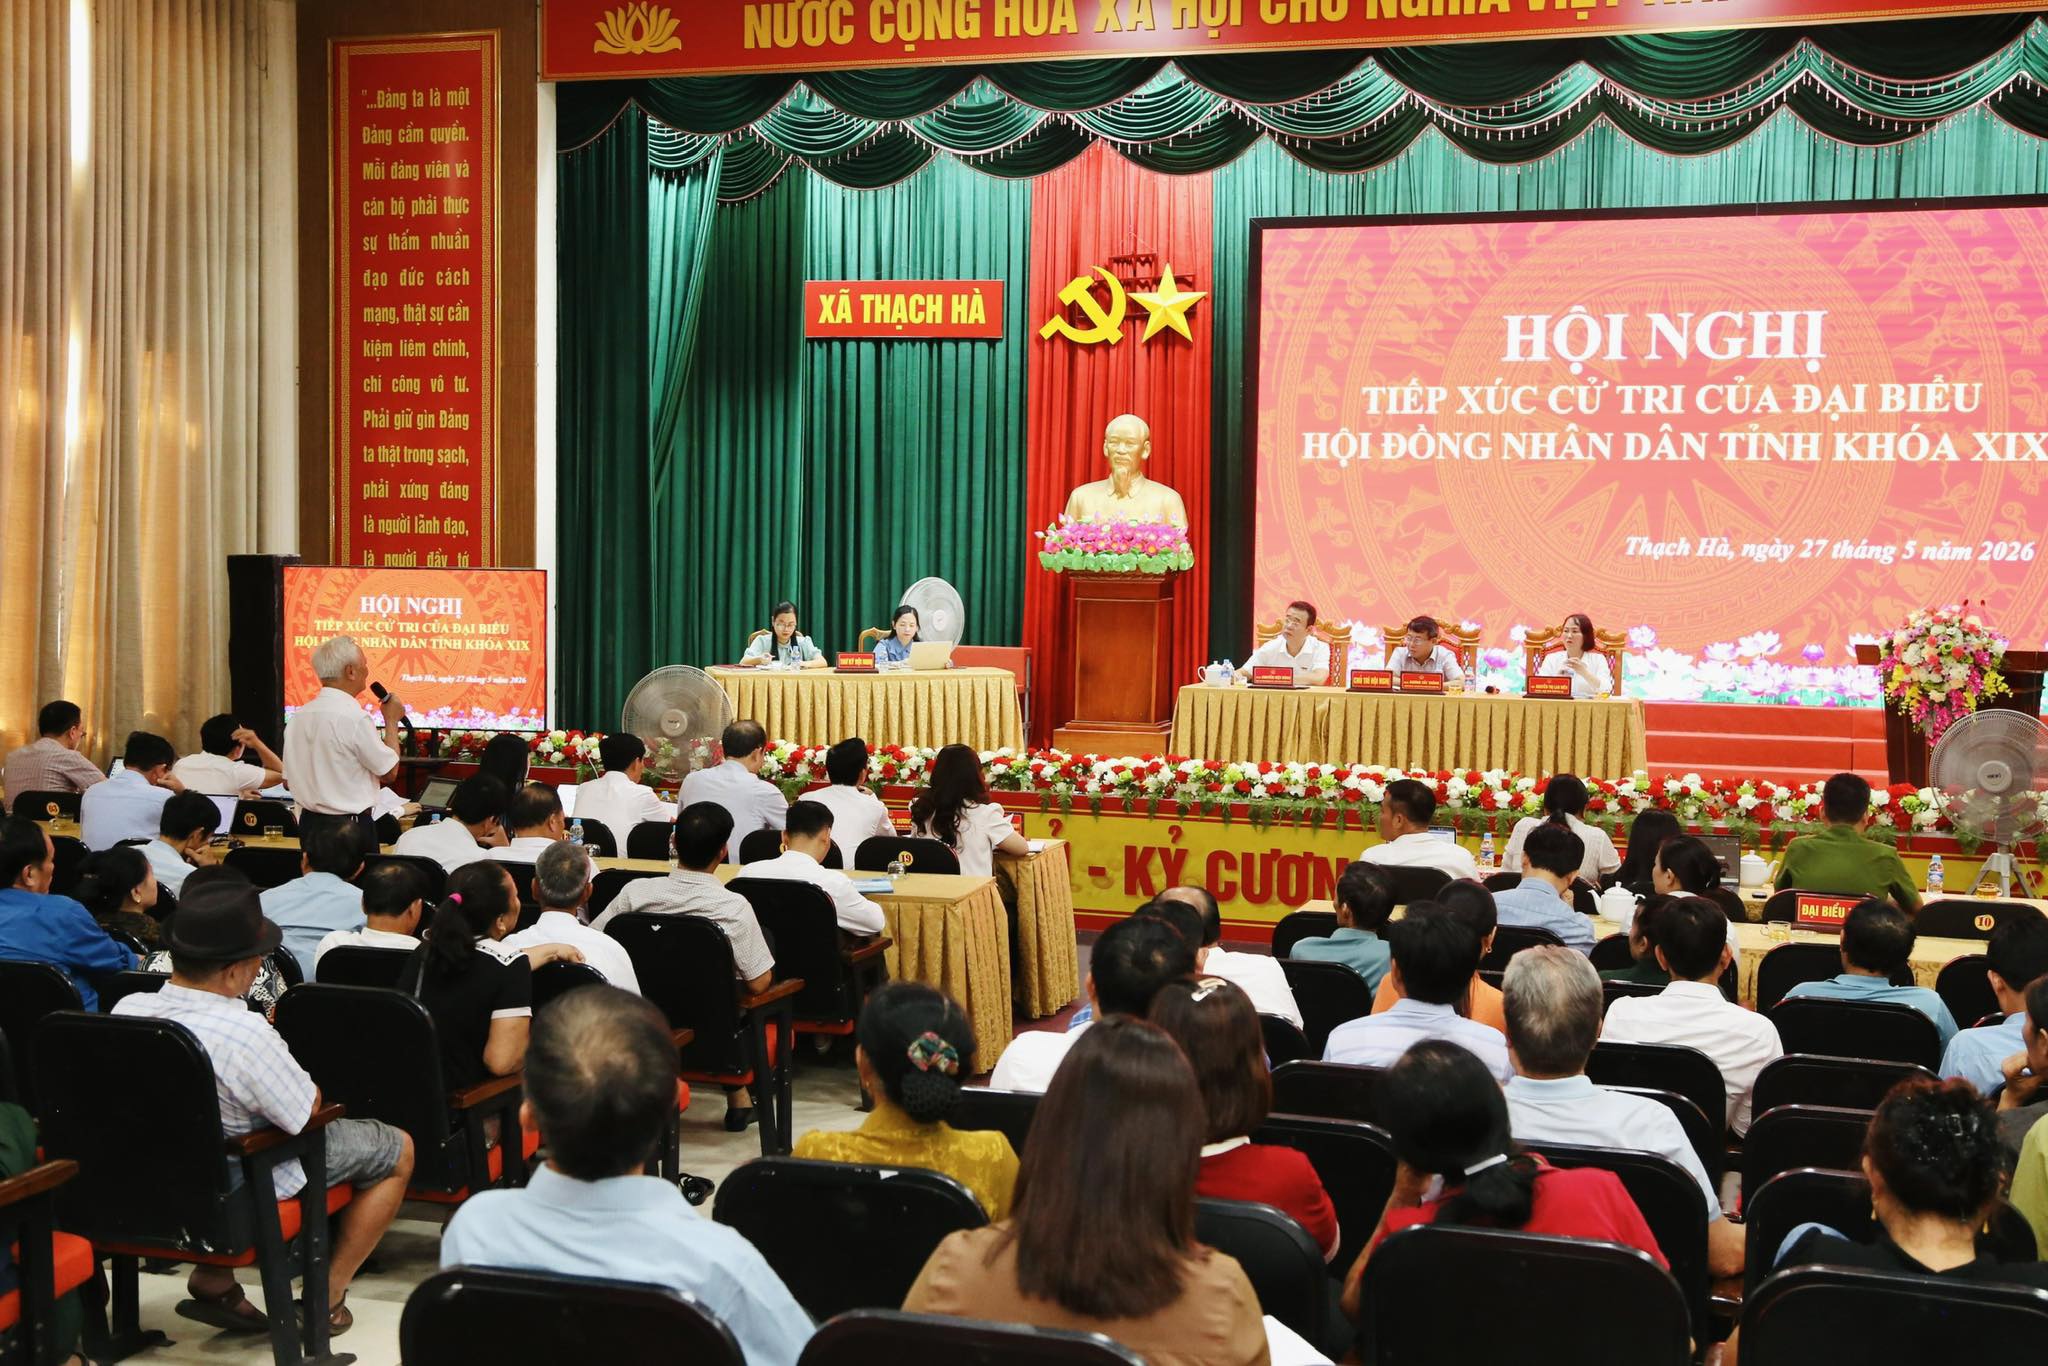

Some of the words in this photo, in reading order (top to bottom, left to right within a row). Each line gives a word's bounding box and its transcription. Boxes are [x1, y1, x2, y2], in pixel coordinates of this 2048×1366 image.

[412, 90, 424, 107] ta
[430, 88, 441, 107] là
[447, 87, 470, 110] một
[362, 123, 392, 145] Đảng
[398, 121, 424, 143] cầm
[430, 119, 470, 144] quyền.
[363, 158, 385, 180] Mỗi
[391, 160, 420, 181] đảng
[425, 160, 450, 178] viên
[456, 159, 470, 178] và
[363, 197, 384, 216] cán
[391, 197, 405, 220] bộ
[411, 194, 437, 217] phải
[443, 196, 470, 218] thực
[363, 234, 378, 254] sự
[388, 229, 420, 250] thấm
[431, 228, 470, 249] nhuần
[363, 269, 387, 290] đạo
[400, 266, 425, 287] đức
[436, 267, 470, 286] cách
[363, 305, 400, 327] mạng,
[403, 303, 427, 326] thật
[430, 304, 445, 325] sự
[447, 299, 470, 322] cần
[818, 288, 853, 324] XÃ
[860, 293, 943, 330] THẠCH
[951, 287, 986, 324] HÀ
[363, 339, 393, 362] kiệm
[400, 339, 426, 357] liêm
[433, 339, 470, 359] chính,
[1501, 305, 1629, 375] HỘI
[1647, 309, 1828, 373] NGHỊ
[363, 375, 381, 393] chí
[391, 374, 421, 395] công
[430, 374, 444, 392] vô
[454, 375, 470, 393] tư.
[1362, 377, 1448, 415] TIẾP
[1456, 378, 1538, 415] XÚC
[1548, 377, 1610, 415] CỬ
[1616, 385, 1685, 414] TRI
[1696, 375, 1782, 414] CỦA
[1792, 383, 1868, 422] ĐẠI
[1879, 373, 1983, 413] BIỂU
[363, 407, 390, 428] Phải
[394, 407, 413, 431] giữ
[416, 410, 435, 431] gìn
[439, 407, 470, 431] Đảng
[363, 445, 374, 463] ta
[377, 444, 401, 467] thật
[403, 445, 434, 466] trong
[437, 444, 470, 468] sạch,
[1302, 427, 1372, 468] HỘI
[1381, 424, 1493, 461] ĐỒNG
[1501, 423, 1614, 461] NHÂN
[1623, 423, 1708, 461] DÂN
[1720, 423, 1822, 461] TỈNH
[1832, 423, 1960, 461] KHÓA
[1970, 432, 2048, 461] XIX
[363, 477, 389, 500] phải
[400, 478, 429, 501] xứng
[440, 480, 470, 502] đáng
[363, 515, 374, 533] là
[378, 513, 411, 536] người
[414, 513, 440, 534] lãnh
[443, 515, 470, 538] đạo,
[1625, 536, 1690, 560] Thạch
[1695, 537, 1735, 560] Hà,
[1741, 538, 1795, 562] ngày
[1800, 539, 1829, 559] 27
[1832, 539, 1897, 565] tháng
[1902, 541, 1917, 560] 5
[1921, 542, 1972, 561] năm
[1978, 542, 2035, 562] 2026
[360, 594, 401, 618] HỘI
[406, 597, 463, 619] NGHỊ
[901, 854, 911, 863] 19
[1124, 824, 1188, 897] KỶ
[1206, 848, 1349, 906] CƯƠN
[1801, 904, 1819, 918] ĐẠI
[1821, 902, 1845, 918] BIỂU
[1977, 916, 1992, 927] 10
